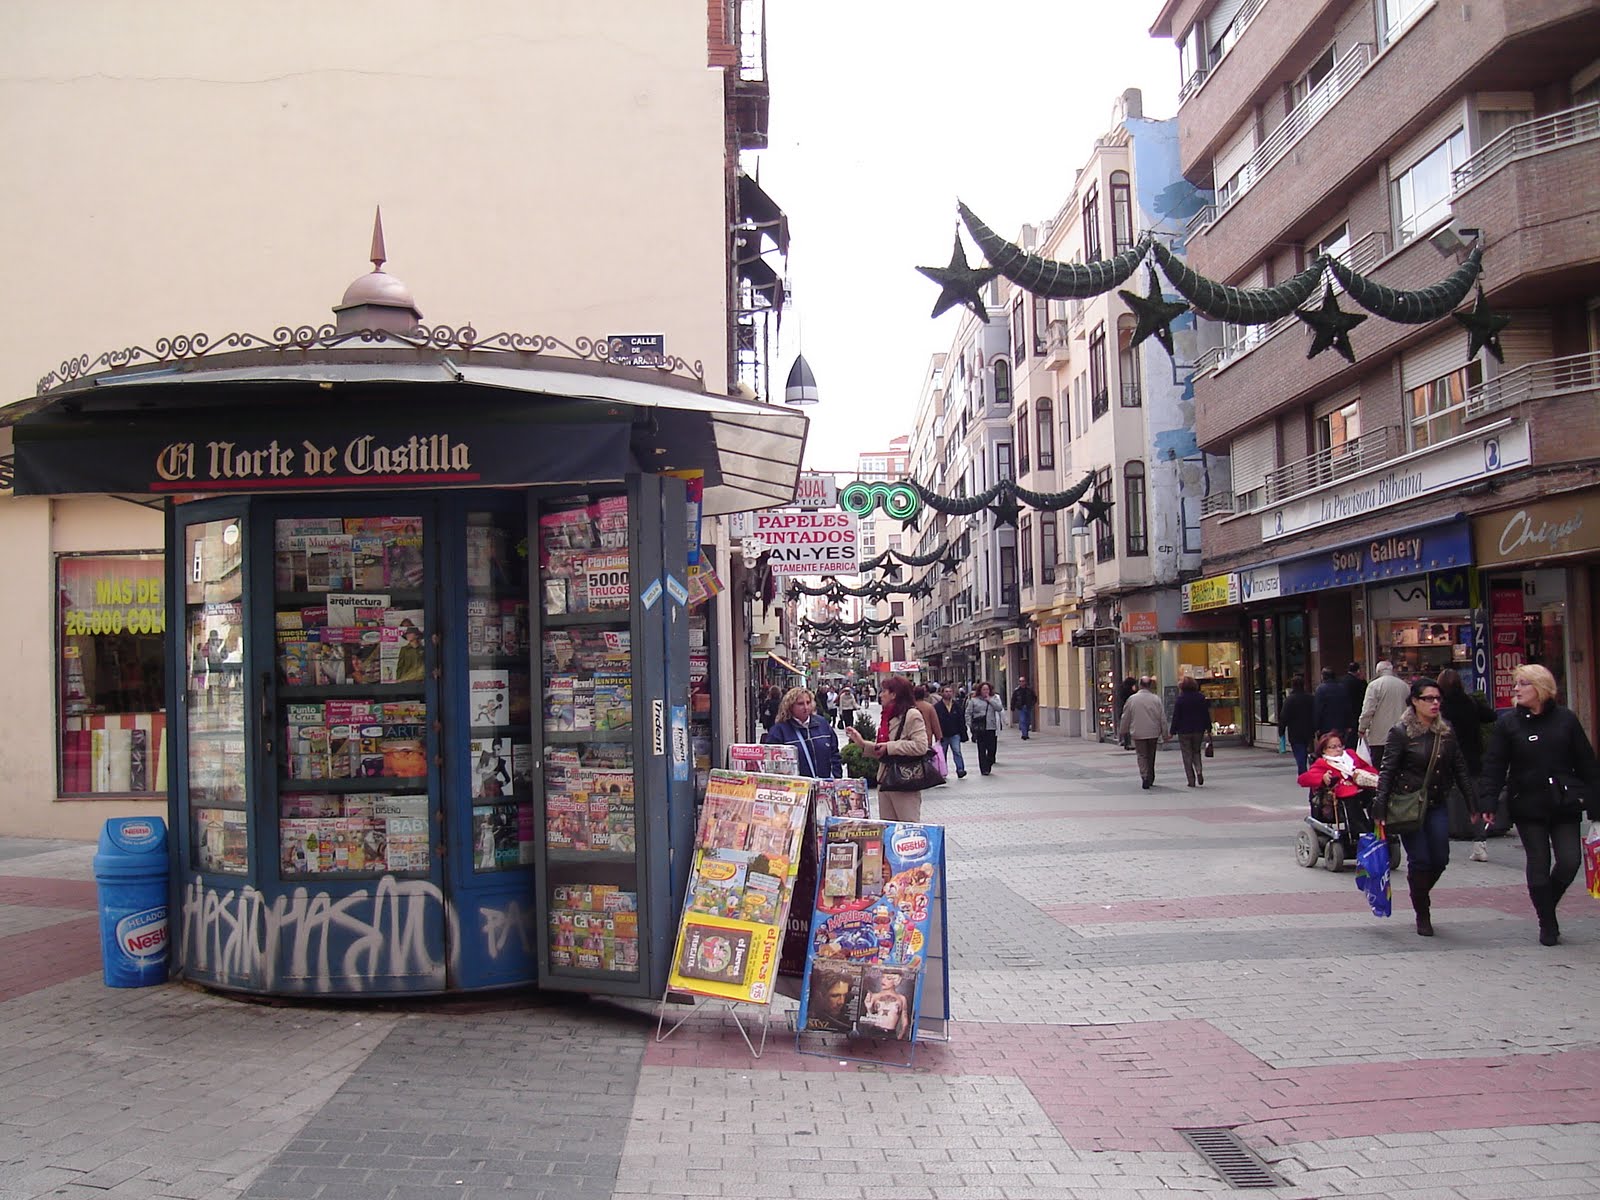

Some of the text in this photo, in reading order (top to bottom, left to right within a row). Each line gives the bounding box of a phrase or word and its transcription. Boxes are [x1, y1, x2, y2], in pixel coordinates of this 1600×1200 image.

[156, 434, 472, 481] El Norte de Castilla
[798, 479, 827, 498] SUAL
[1320, 471, 1423, 522] La Previsora Bilbaína
[758, 514, 850, 529] PAPELES
[1332, 537, 1422, 571] Sony Gallery
[819, 562, 857, 572] FABRICA
[589, 572, 629, 587] 5000
[97, 578, 133, 605] MAS
[136, 578, 161, 604] DE
[329, 597, 382, 607] arquitectura
[589, 586, 631, 596] TRUCOS
[65, 610, 122, 636] 20.000
[605, 633, 619, 643] PC
[290, 706, 317, 714] Punto
[654, 701, 662, 753] Trident
[757, 793, 793, 803] caballo
[733, 938, 747, 976] el jueves
[758, 928, 776, 980] el jueves
